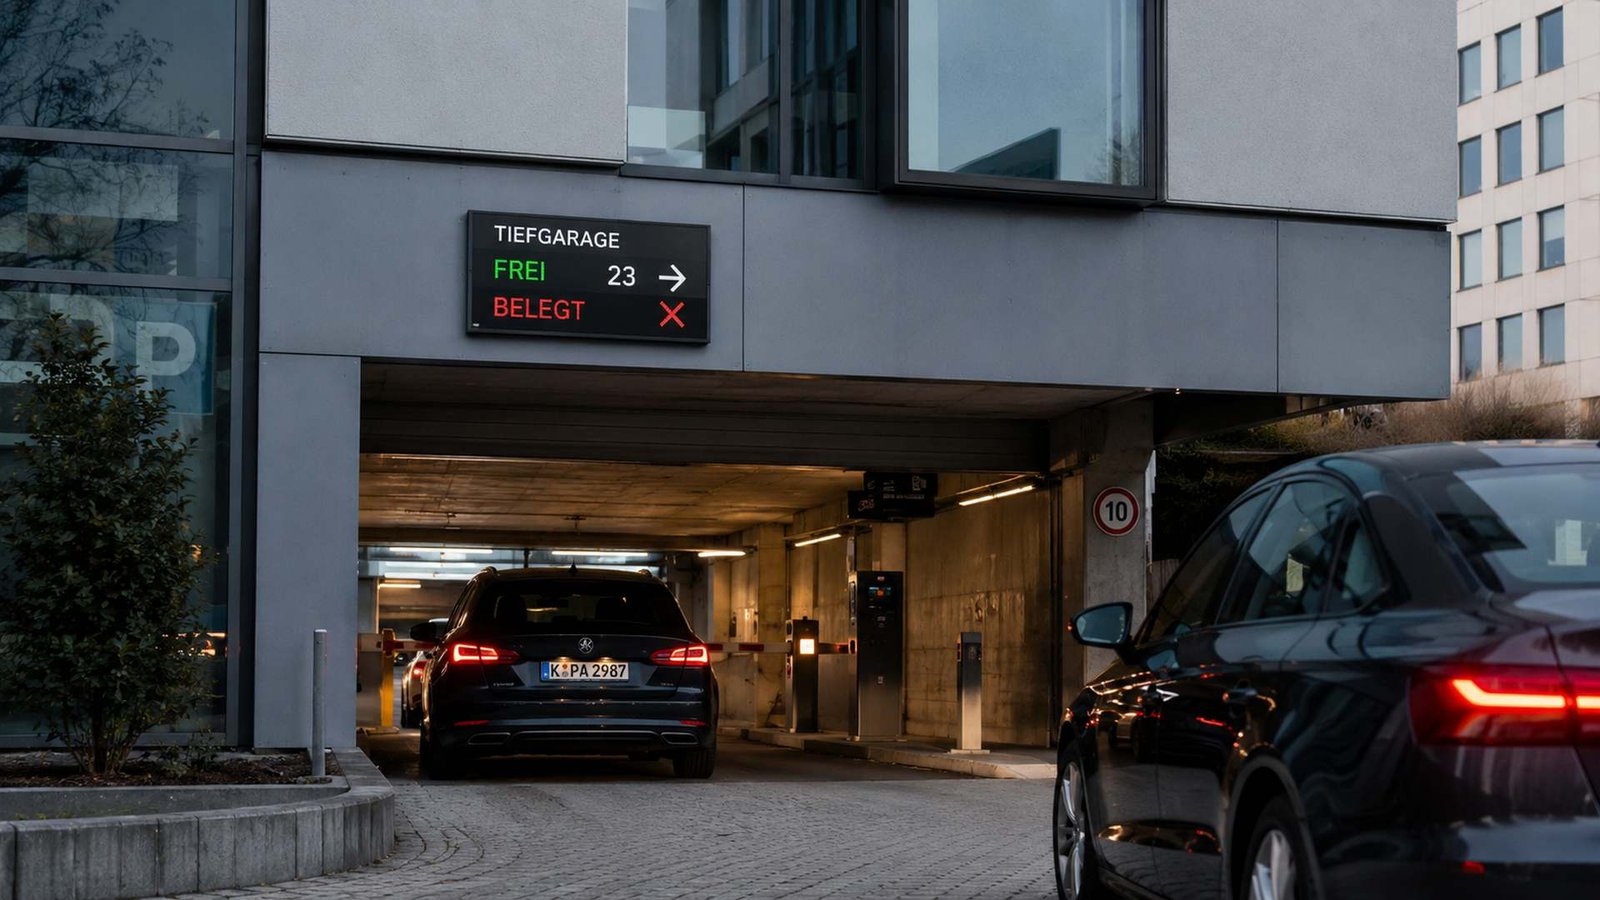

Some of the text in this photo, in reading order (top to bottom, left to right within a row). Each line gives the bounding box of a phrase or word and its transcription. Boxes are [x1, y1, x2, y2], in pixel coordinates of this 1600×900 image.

[494, 225, 620, 249] TIEFGARAGE
[494, 259, 636, 286] FREI 23
[494, 297, 585, 320] BELEGT
[136, 321, 196, 401] P
[1105, 501, 1127, 522] 10
[551, 664, 626, 677] K PA 2987
